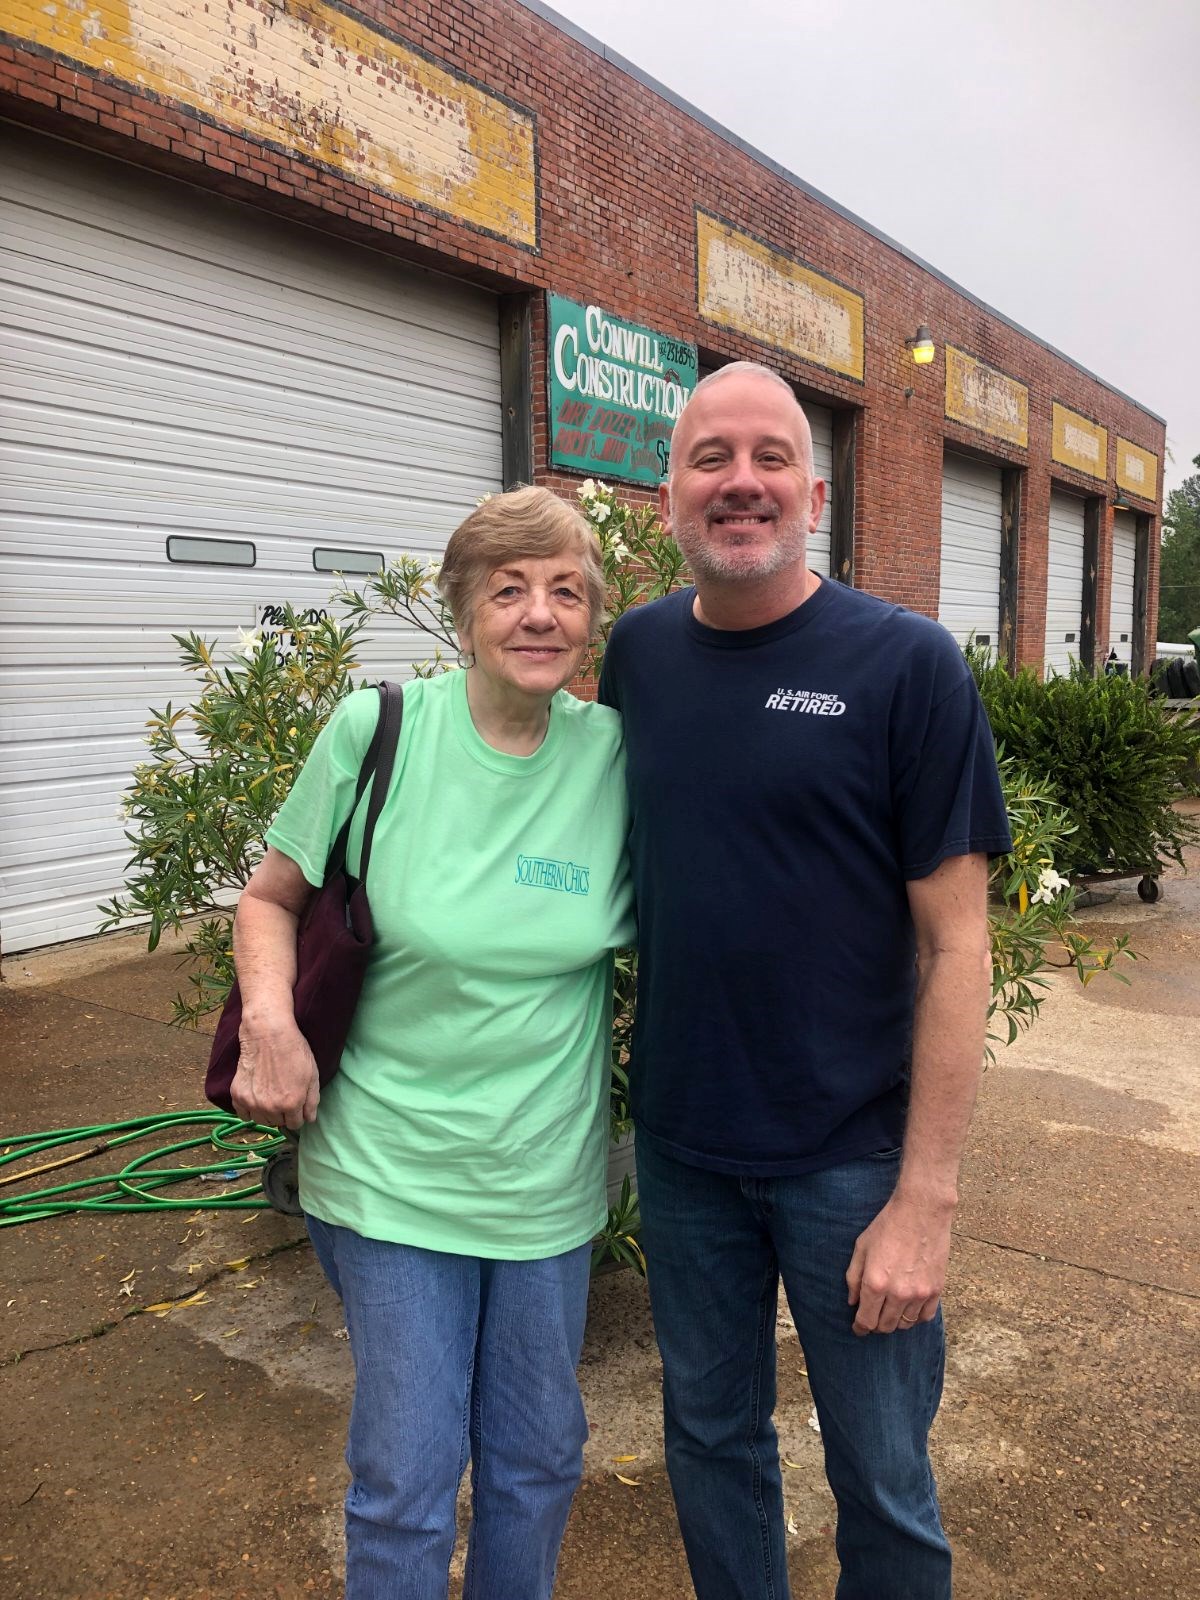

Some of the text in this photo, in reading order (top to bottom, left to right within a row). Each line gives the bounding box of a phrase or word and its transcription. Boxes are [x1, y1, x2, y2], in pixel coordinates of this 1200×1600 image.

[586, 305, 663, 372] CONWILL
[554, 324, 690, 420] CONSTRUCTION
[765, 694, 846, 716] RETIRED
[795, 690, 810, 698] AIR
[810, 692, 838, 701] FORCE
[515, 854, 589, 893] SOUTHERN CHICS
